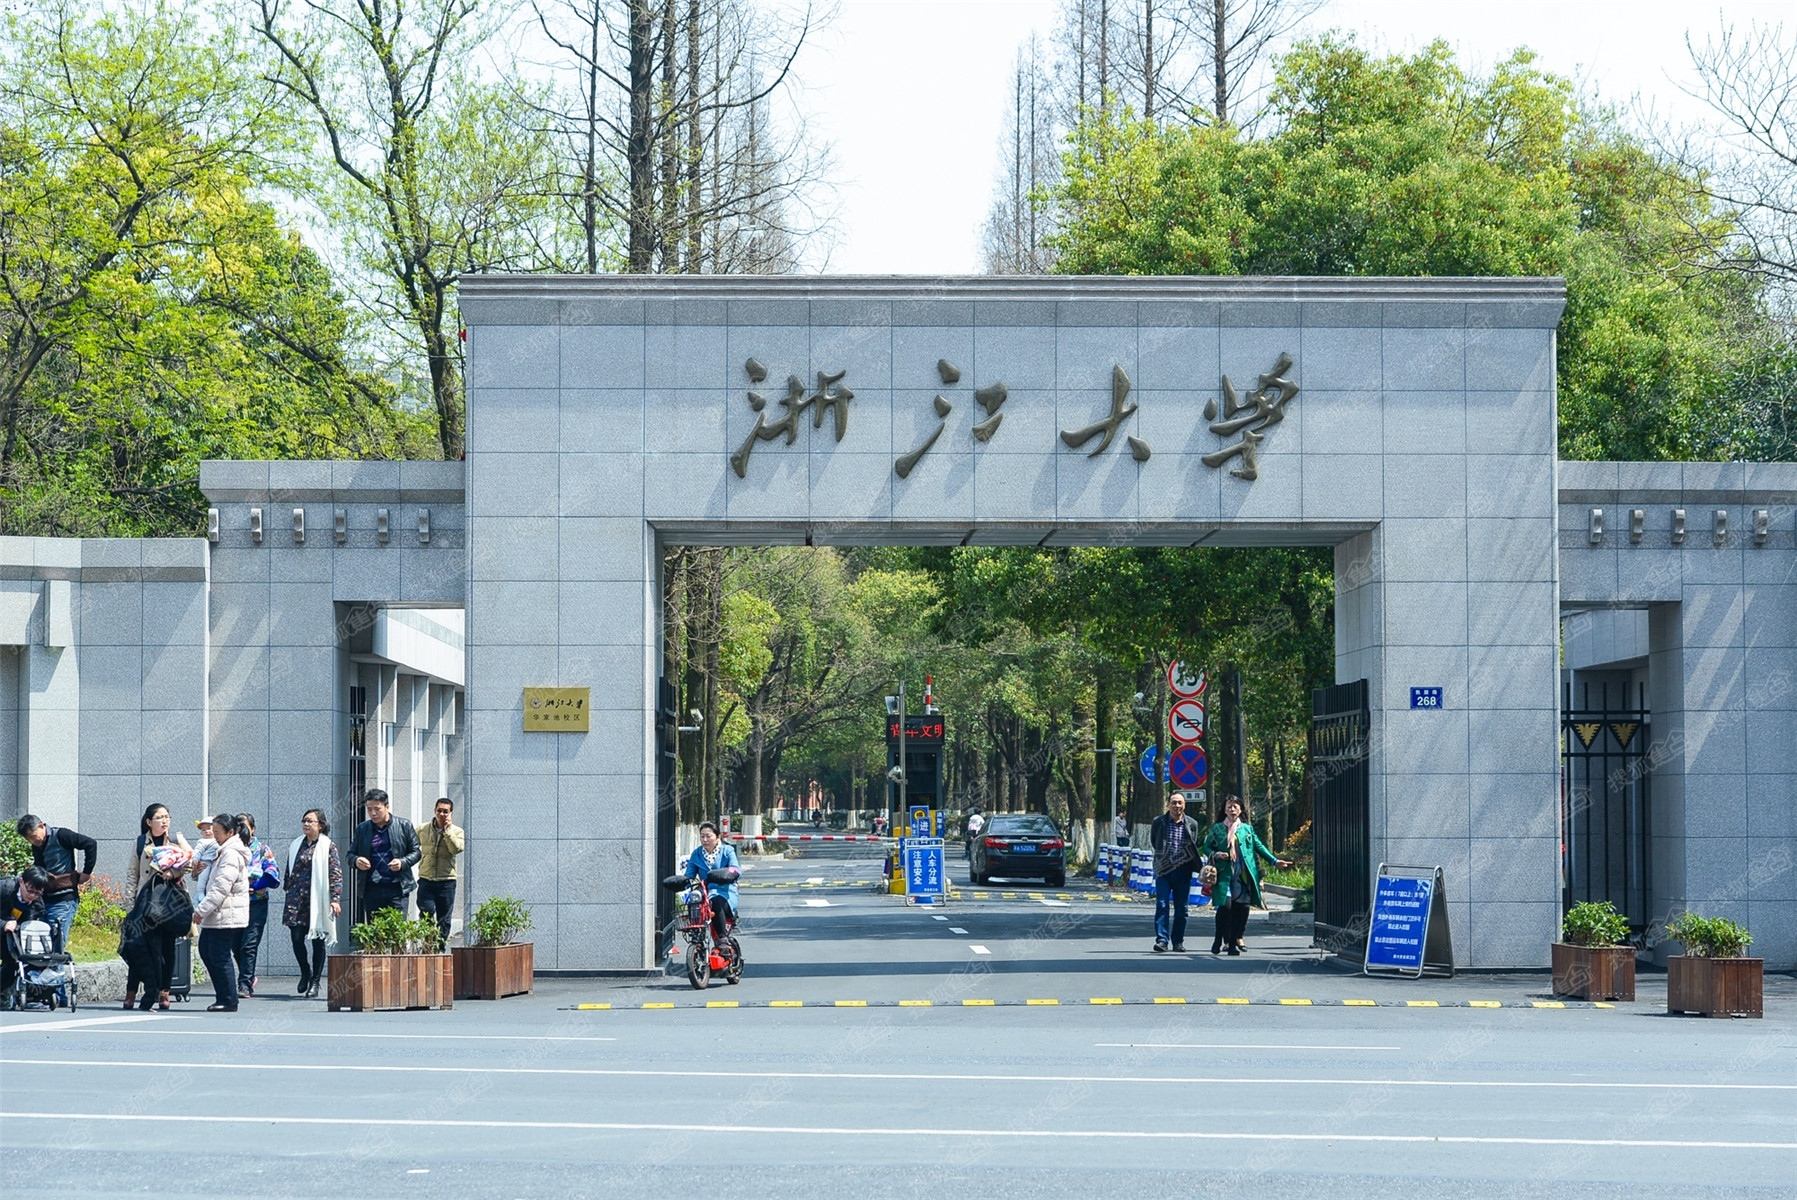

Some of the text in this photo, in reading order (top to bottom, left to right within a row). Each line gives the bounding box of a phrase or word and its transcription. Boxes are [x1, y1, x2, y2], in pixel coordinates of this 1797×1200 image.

[1417, 696, 1437, 706] 268
[912, 850, 923, 885] 注意安全
[927, 850, 938, 885] 人车分流
